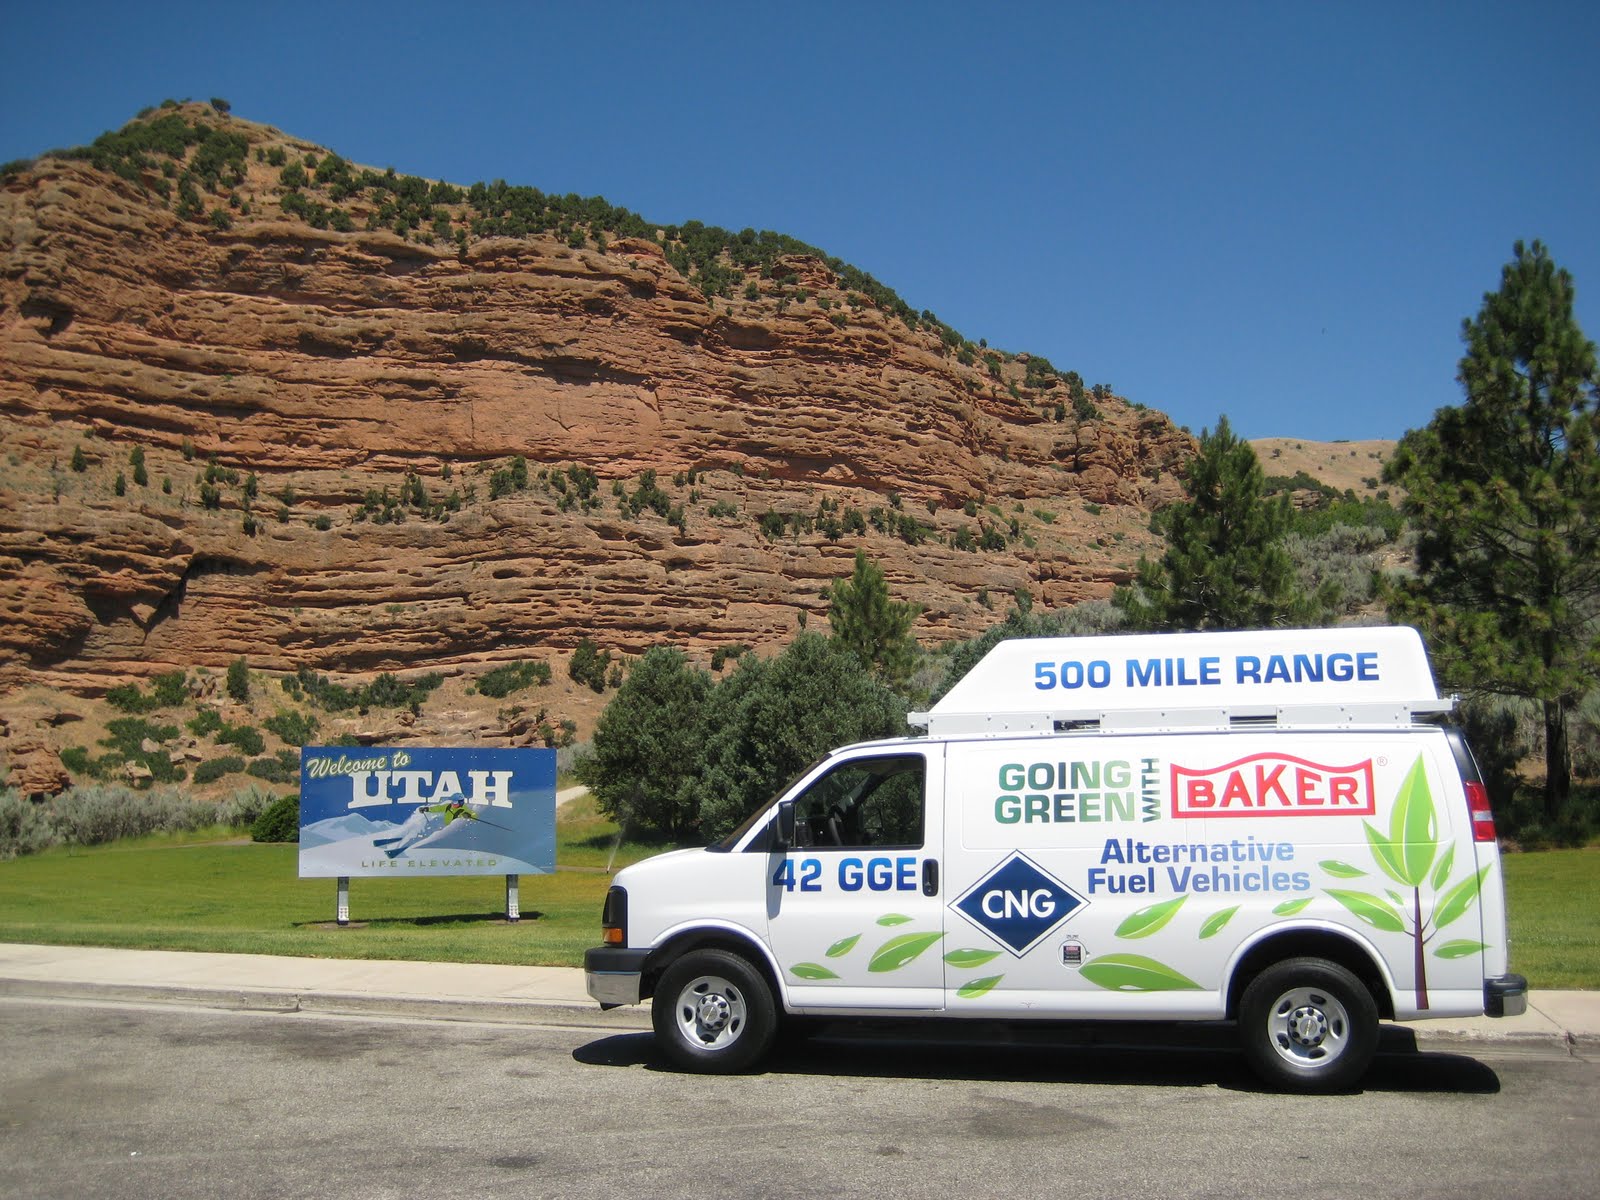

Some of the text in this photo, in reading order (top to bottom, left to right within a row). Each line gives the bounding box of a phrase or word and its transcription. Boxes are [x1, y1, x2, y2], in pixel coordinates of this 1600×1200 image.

[1034, 652, 1380, 690] 500 MILE RANGE
[306, 751, 411, 779] Welcome to
[998, 760, 1131, 792] GOING
[347, 770, 513, 809] UTAH
[1141, 757, 1161, 823] WITH
[1187, 764, 1359, 809] BAKER
[994, 791, 1135, 825] GREEN
[361, 859, 497, 868] LIFE ELEVATED
[1100, 835, 1294, 865] Alternative
[773, 857, 918, 892] 42 GGE
[1088, 865, 1310, 895] Fuel Vehicles
[981, 888, 1056, 919] CNG
